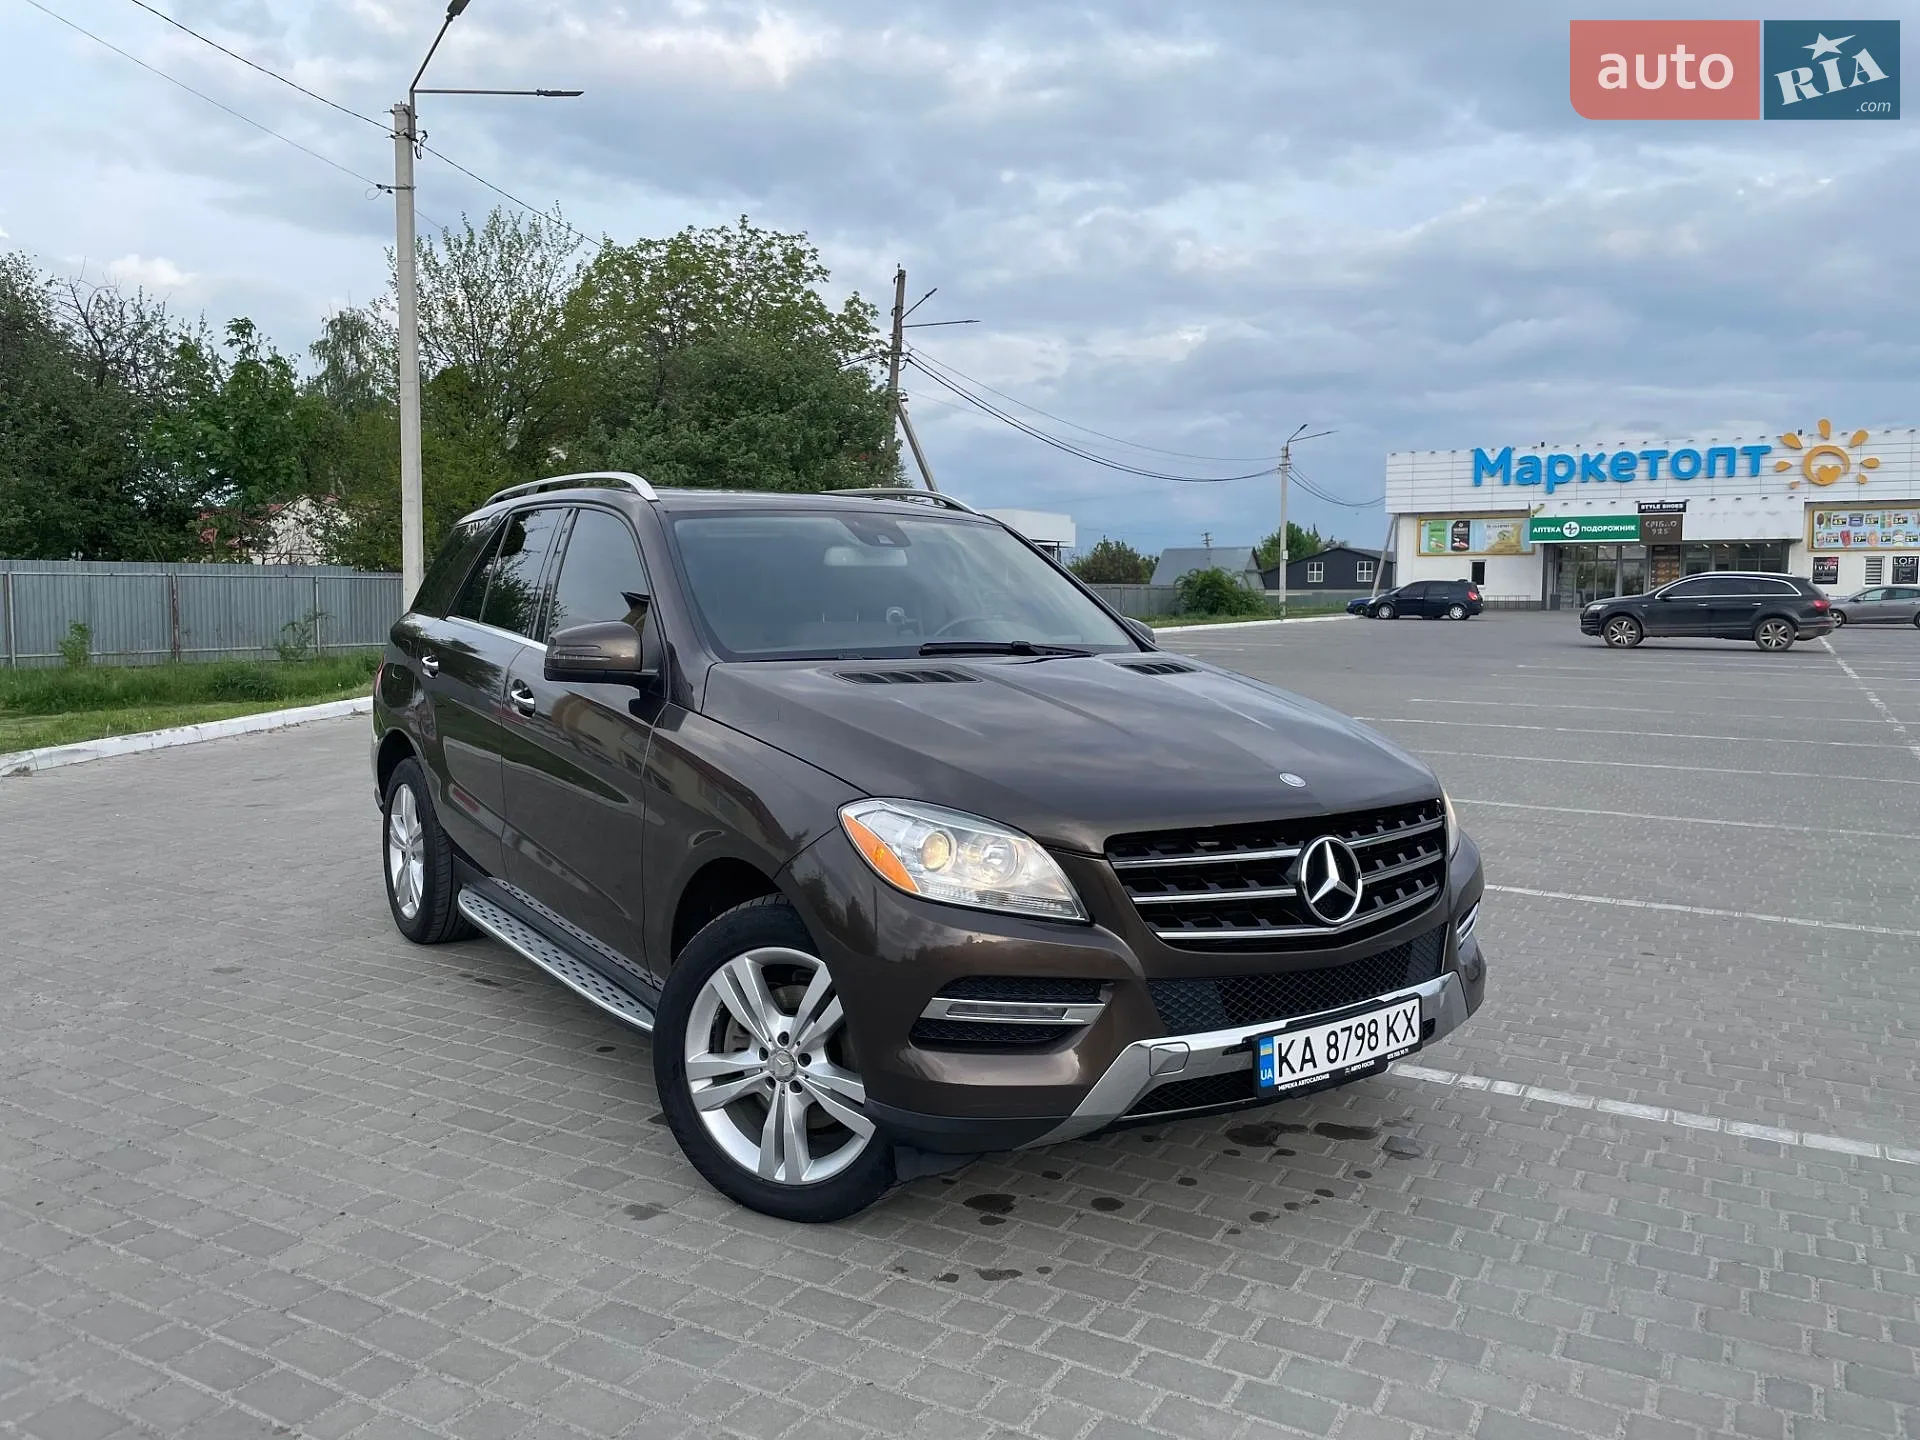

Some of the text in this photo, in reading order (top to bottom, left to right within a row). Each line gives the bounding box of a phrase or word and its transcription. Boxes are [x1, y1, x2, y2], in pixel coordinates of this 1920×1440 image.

[1472, 444, 1772, 495] Маркетопт
[1532, 524, 1636, 534] АПТЕКА ПОДОРОЖНИК
[1893, 557, 1918, 565] LOFT
[1277, 1005, 1417, 1078] KA 8798 KX
[1260, 1069, 1273, 1081] UA
